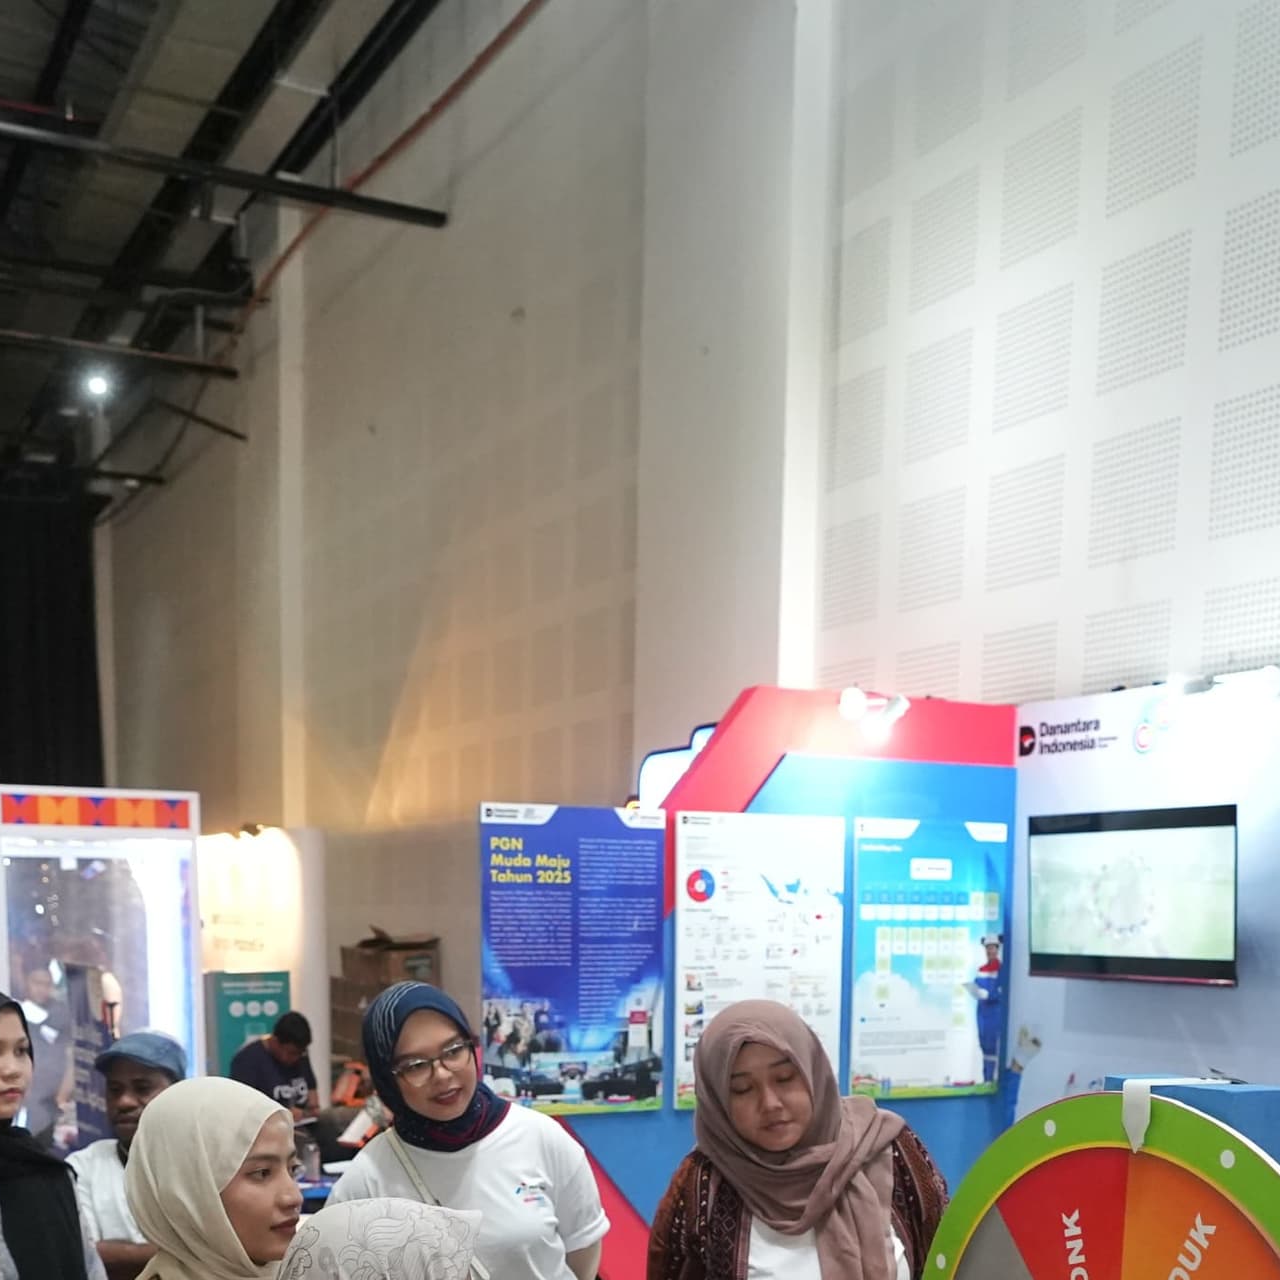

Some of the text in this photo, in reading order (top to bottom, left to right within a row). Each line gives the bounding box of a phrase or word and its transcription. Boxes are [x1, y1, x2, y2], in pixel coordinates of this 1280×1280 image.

[1040, 719, 1100, 737] Danantara
[1039, 737, 1096, 755] Indonesia
[490, 837, 523, 850] PGN
[490, 853, 570, 872] Muda Maju
[490, 869, 572, 883] Tahun 2025
